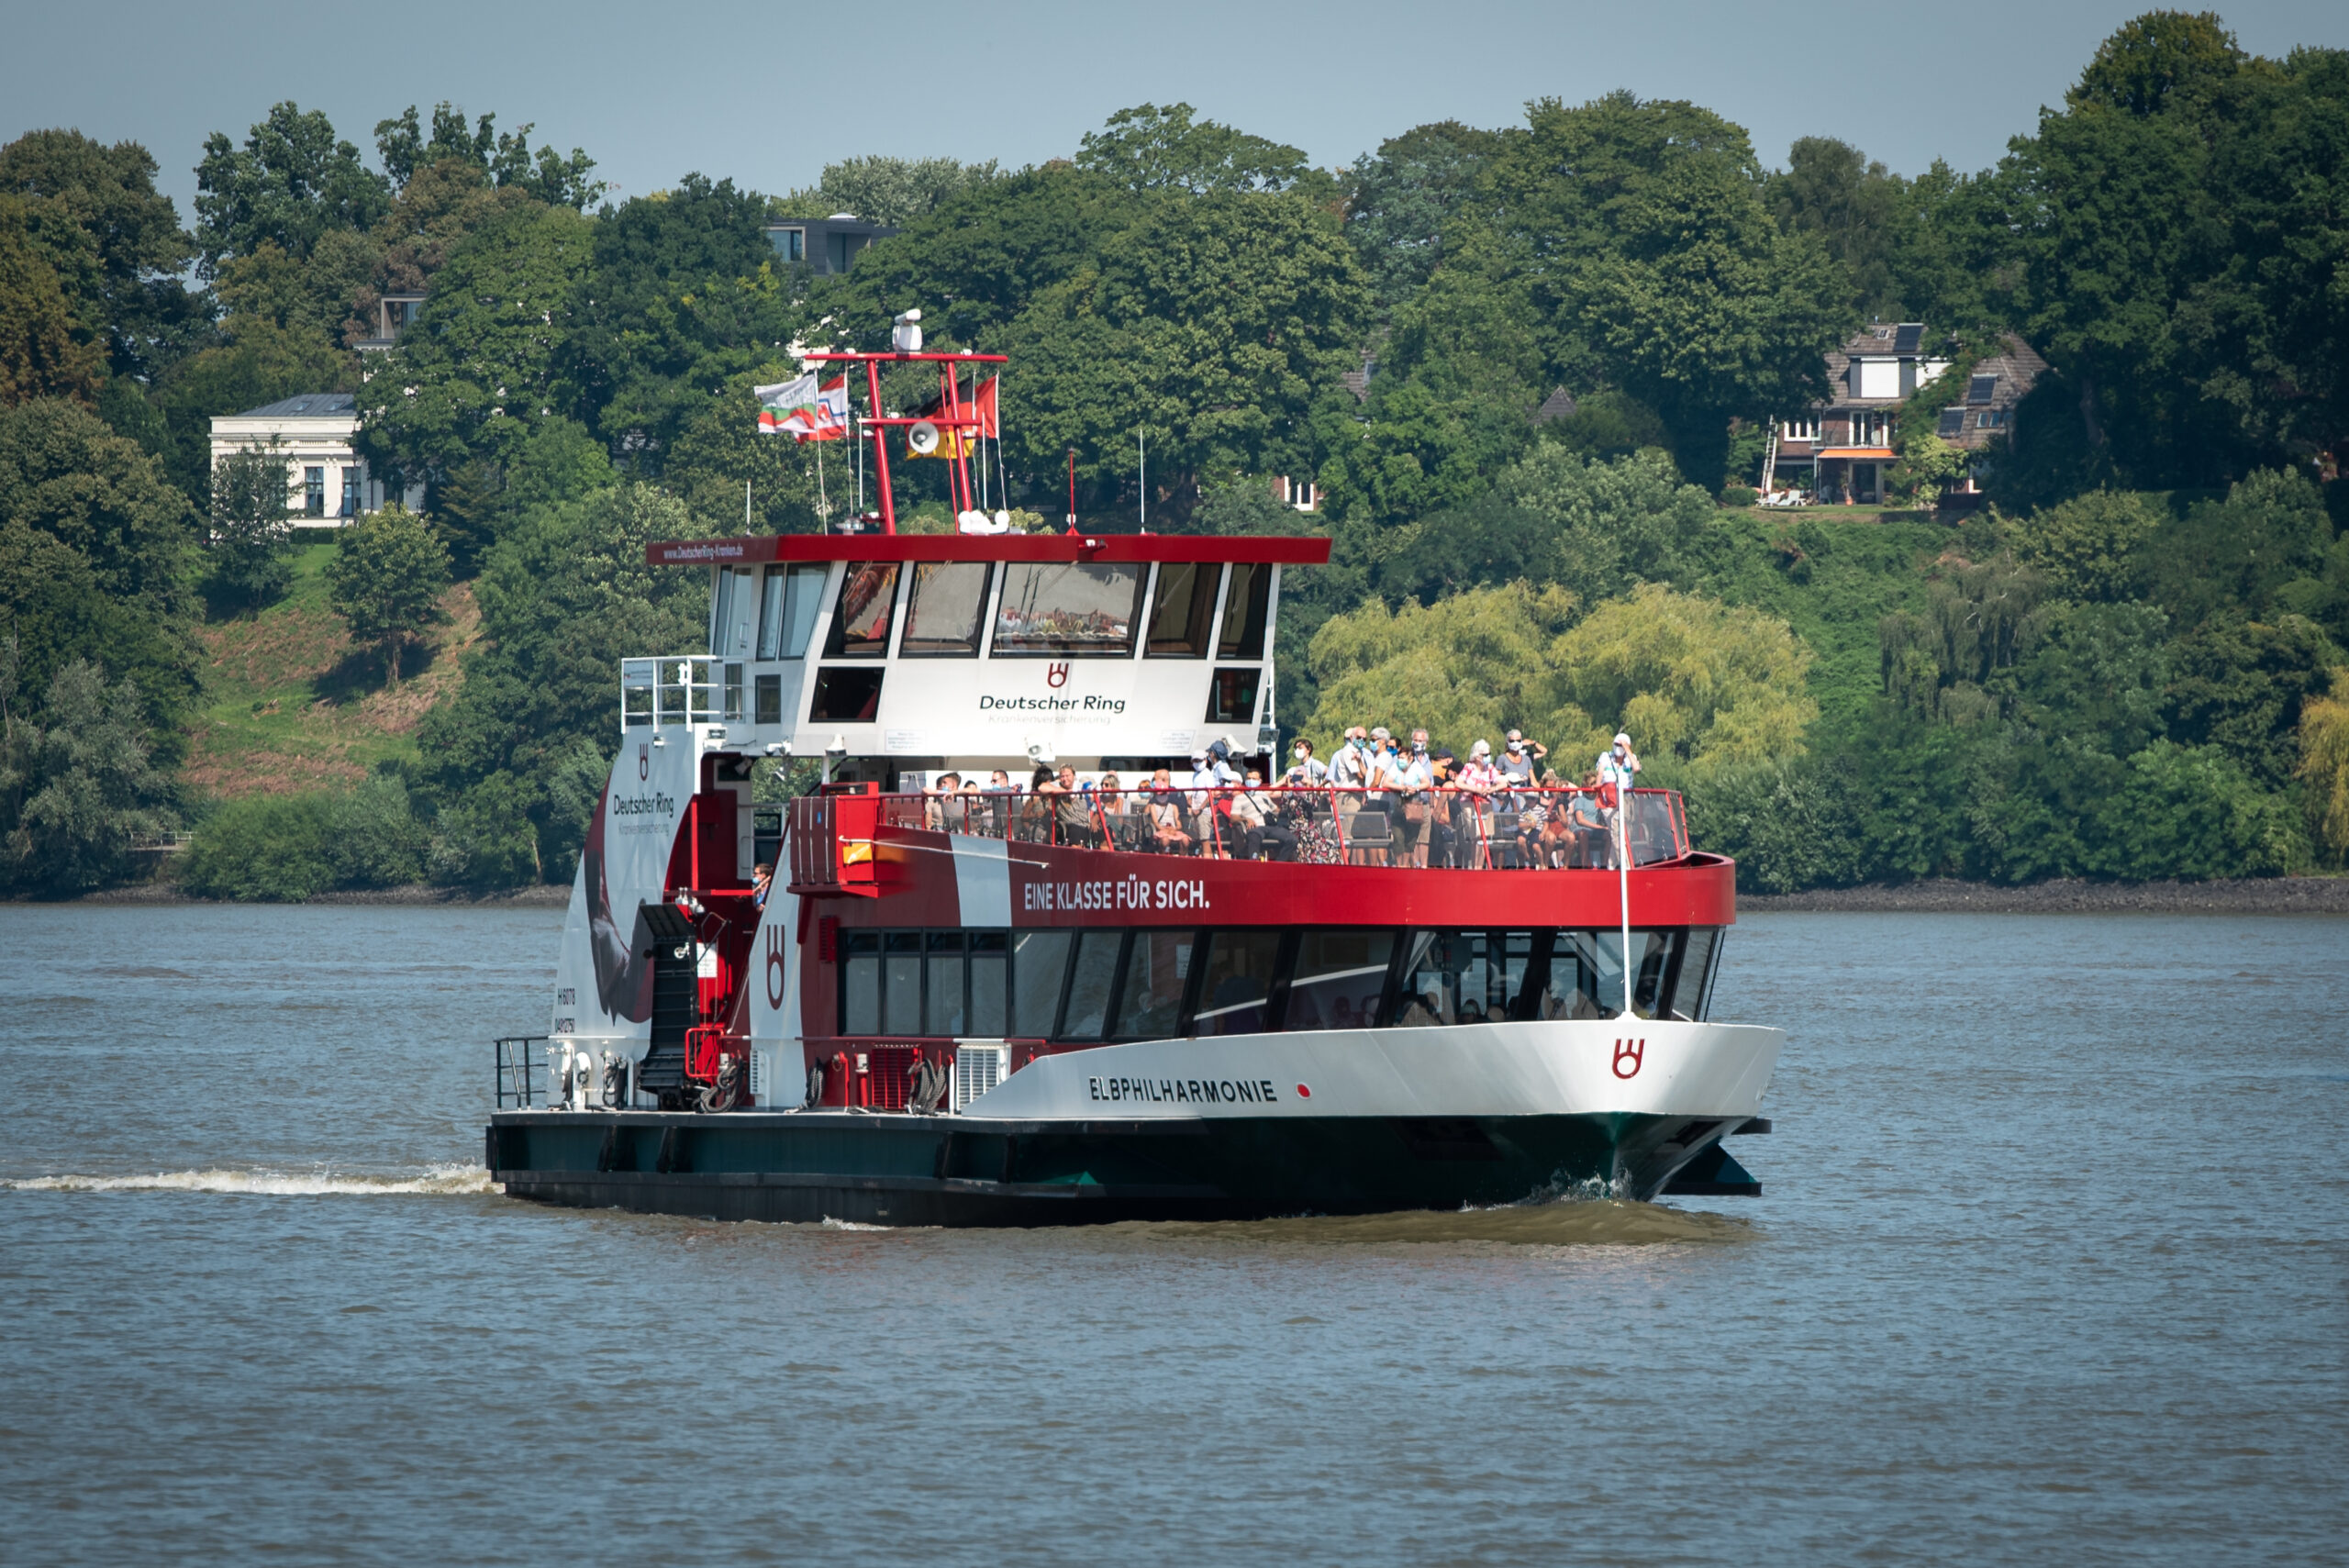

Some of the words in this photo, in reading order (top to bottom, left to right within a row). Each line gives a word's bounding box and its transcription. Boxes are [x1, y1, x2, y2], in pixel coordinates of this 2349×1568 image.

[979, 695, 1079, 710] Deutscher
[1084, 695, 1126, 714] Ring
[988, 713, 1111, 726] Krankenversicherung
[614, 792, 655, 816] Deutscher
[656, 791, 674, 818] Ring
[1024, 882, 1053, 910] EINE
[1057, 881, 1112, 910] KLASSE
[1117, 873, 1151, 909] FÜR
[1155, 880, 1210, 909] SICH.
[1088, 1075, 1278, 1103] ELBPHILHARMONIE
